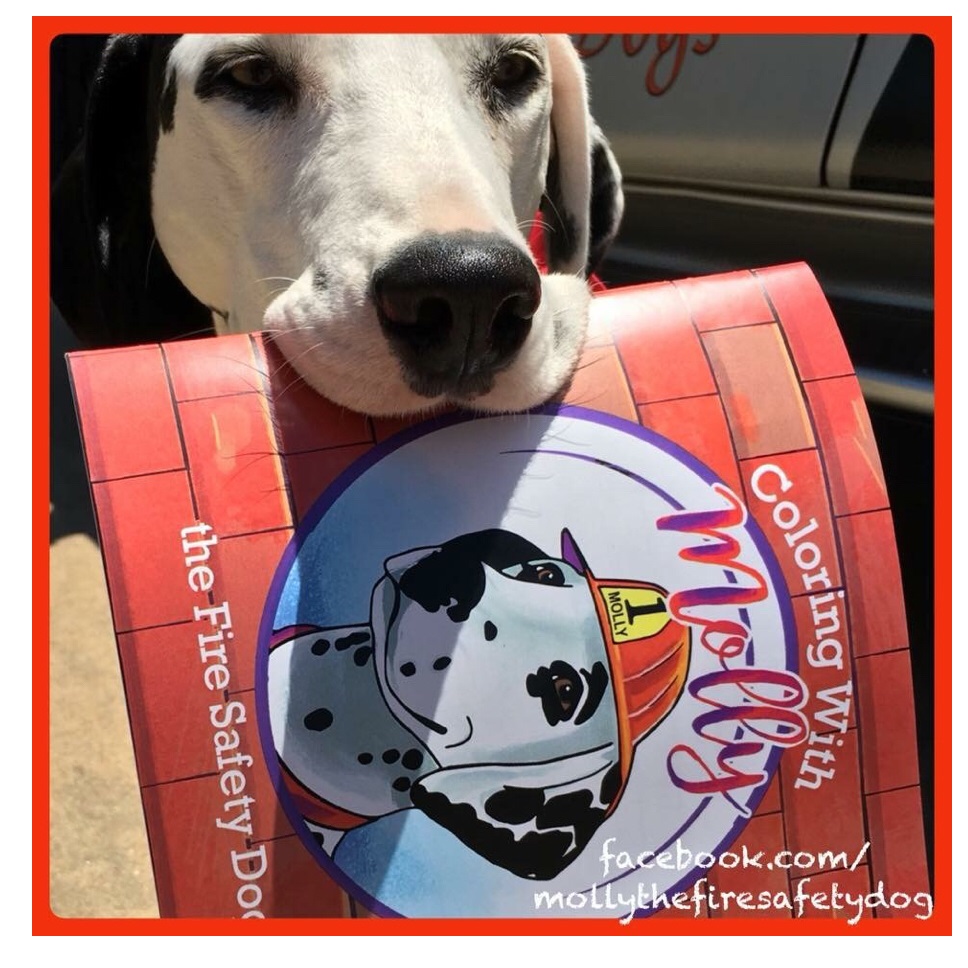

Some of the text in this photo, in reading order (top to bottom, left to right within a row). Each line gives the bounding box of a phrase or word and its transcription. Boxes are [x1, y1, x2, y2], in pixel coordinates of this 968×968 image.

[180, 522, 217, 593] the
[607, 591, 628, 636] MOLLY
[193, 601, 234, 691] Fire
[655, 482, 810, 818] Molly
[750, 463, 853, 790] Coloring With
[208, 701, 255, 836] Safety
